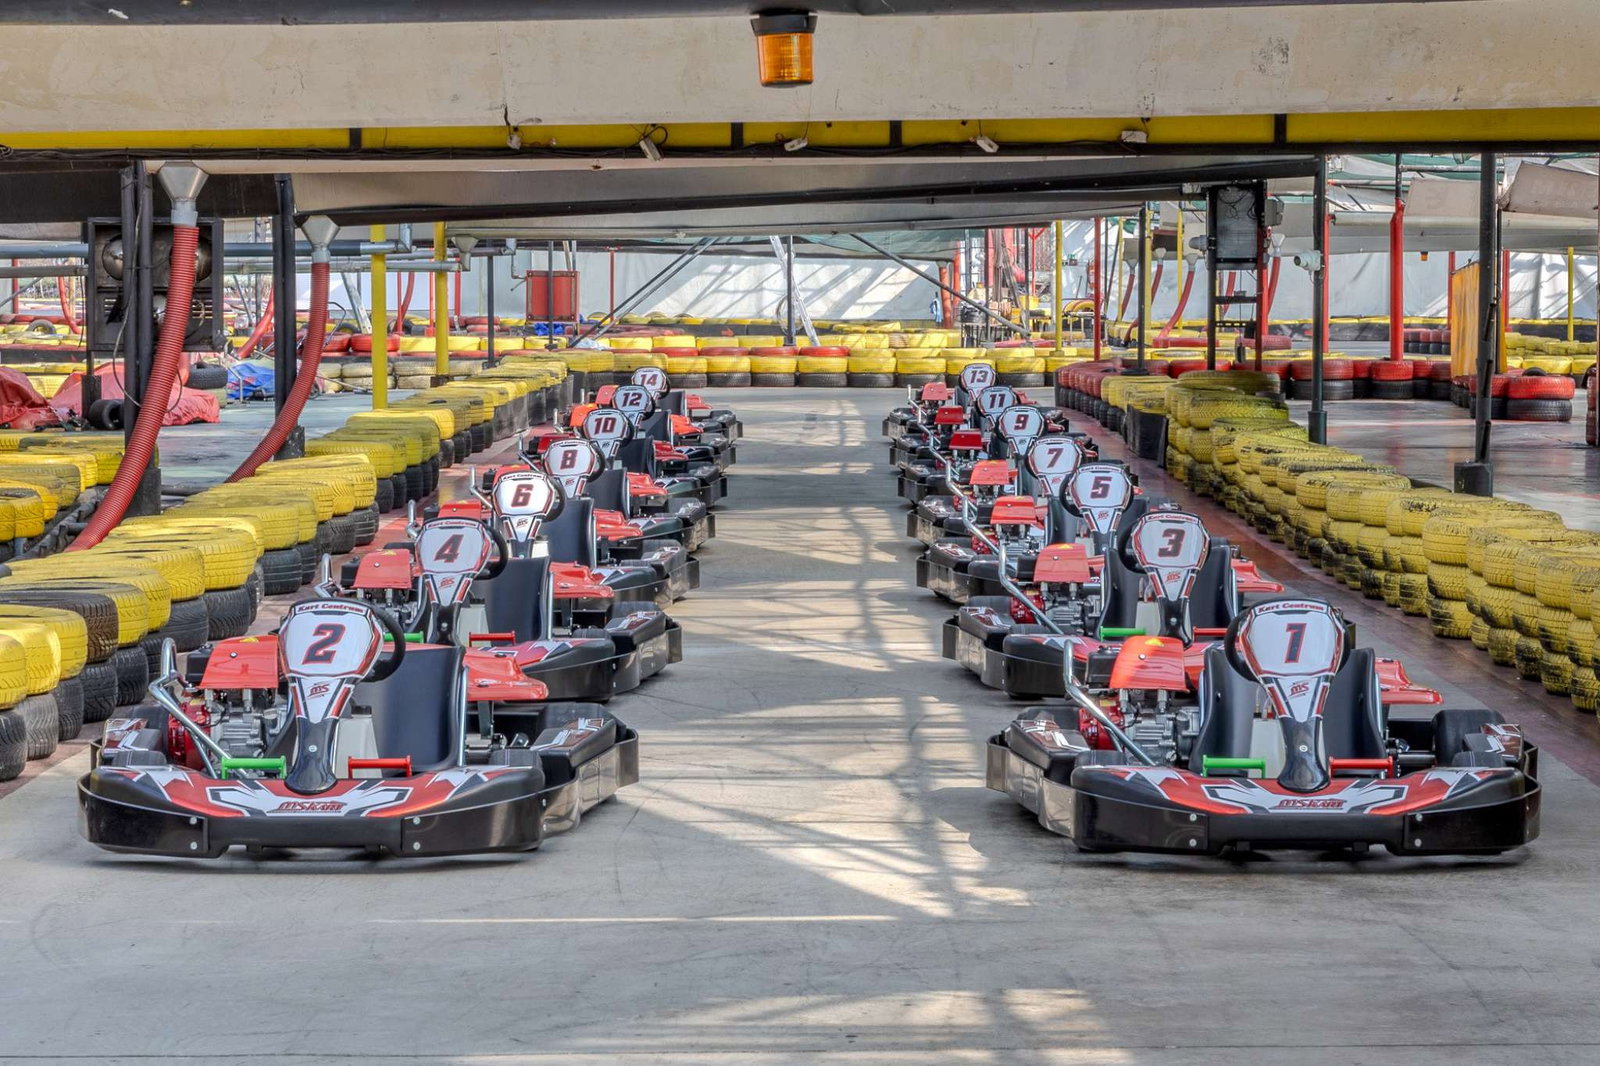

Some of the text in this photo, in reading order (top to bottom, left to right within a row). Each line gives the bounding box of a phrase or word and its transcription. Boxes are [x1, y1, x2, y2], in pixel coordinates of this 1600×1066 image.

[640, 373, 658, 386] 14
[970, 370, 989, 384] 13
[622, 392, 642, 407] 12
[989, 393, 1006, 409] 11
[594, 416, 617, 435] 10
[1013, 413, 1029, 430] 9
[560, 449, 578, 470] 8
[1046, 447, 1064, 469] 7
[511, 484, 534, 508] 6
[1090, 476, 1113, 499] 5
[433, 534, 465, 563] 4
[1157, 528, 1186, 558] 3
[298, 603, 363, 613] Kart Centrum
[1258, 602, 1324, 613] Kart Centrum
[301, 623, 346, 665] 2
[1284, 622, 1307, 663] 1
